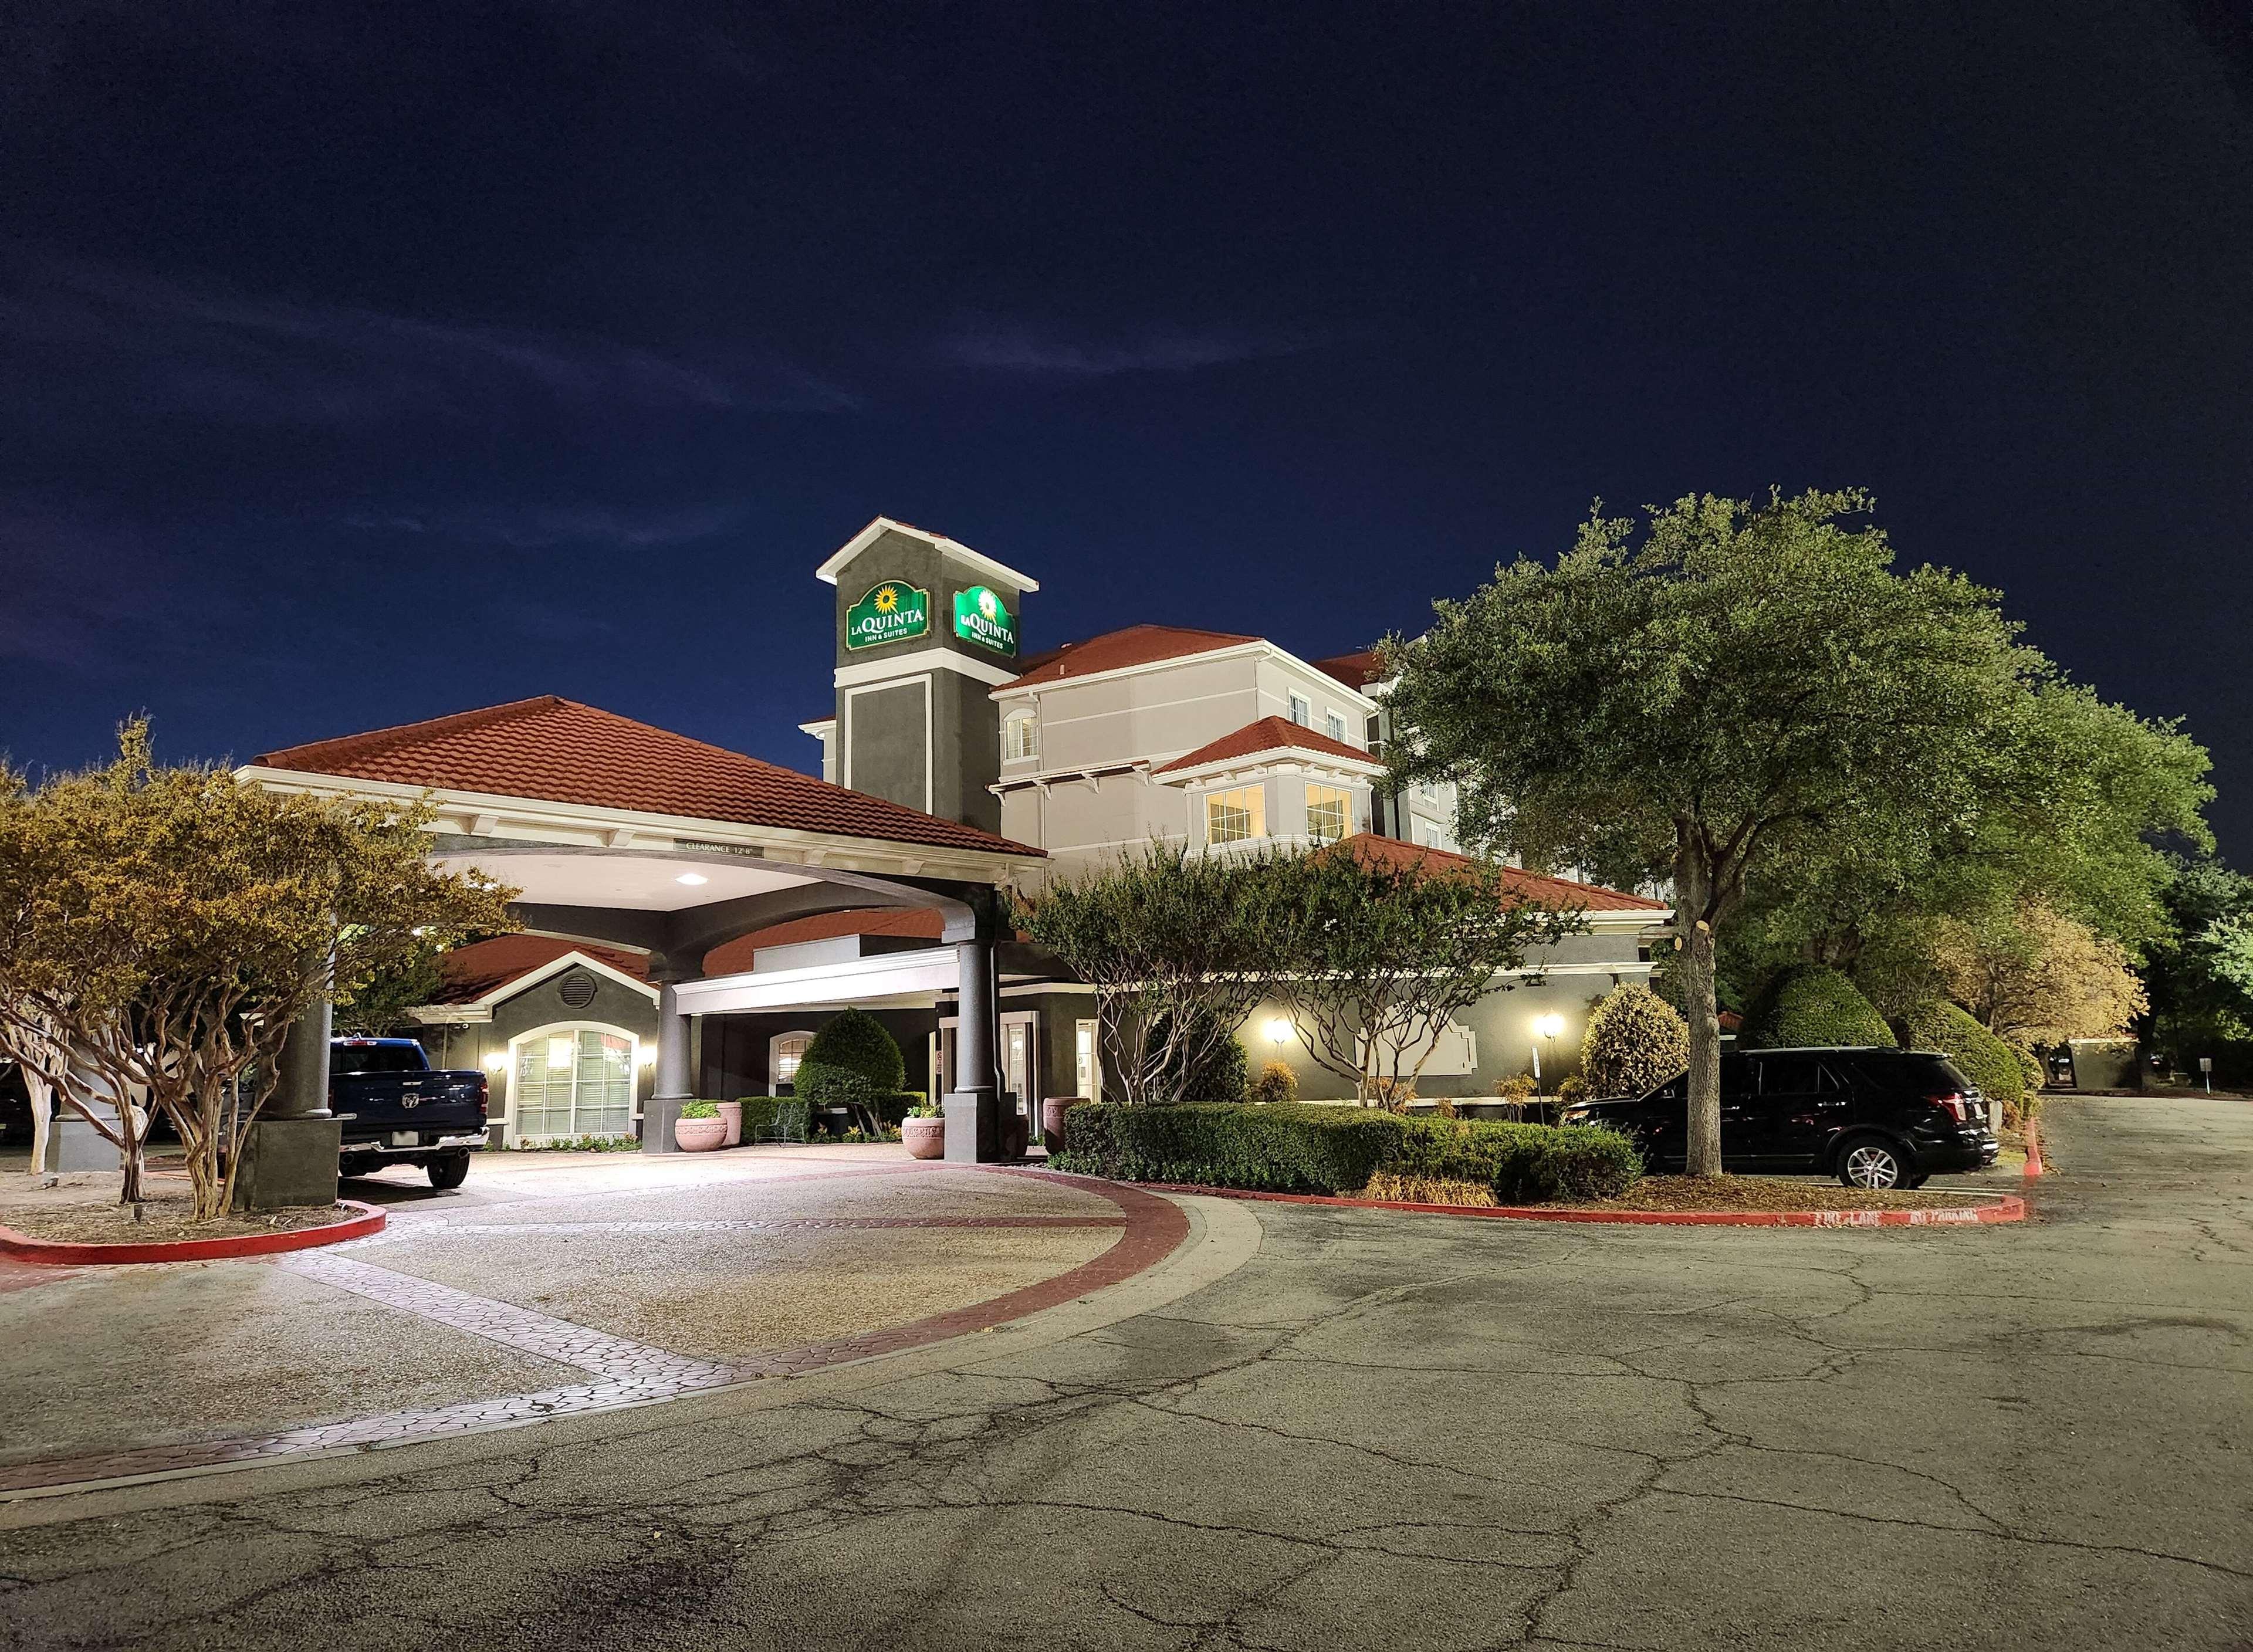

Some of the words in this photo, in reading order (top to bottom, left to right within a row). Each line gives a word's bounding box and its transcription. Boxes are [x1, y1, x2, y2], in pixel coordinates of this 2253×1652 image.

[851, 625, 862, 635] LA
[861, 608, 925, 634] QUINTA
[960, 614, 970, 627] LA
[970, 613, 1014, 644] QUINTA
[883, 628, 908, 638] SUITES
[972, 631, 981, 641] INN
[985, 637, 1003, 649] SUITES
[686, 842, 730, 852] CLEARANCE
[1849, 1211, 1880, 1226] LANE
[1931, 1208, 1978, 1221] PARKING
